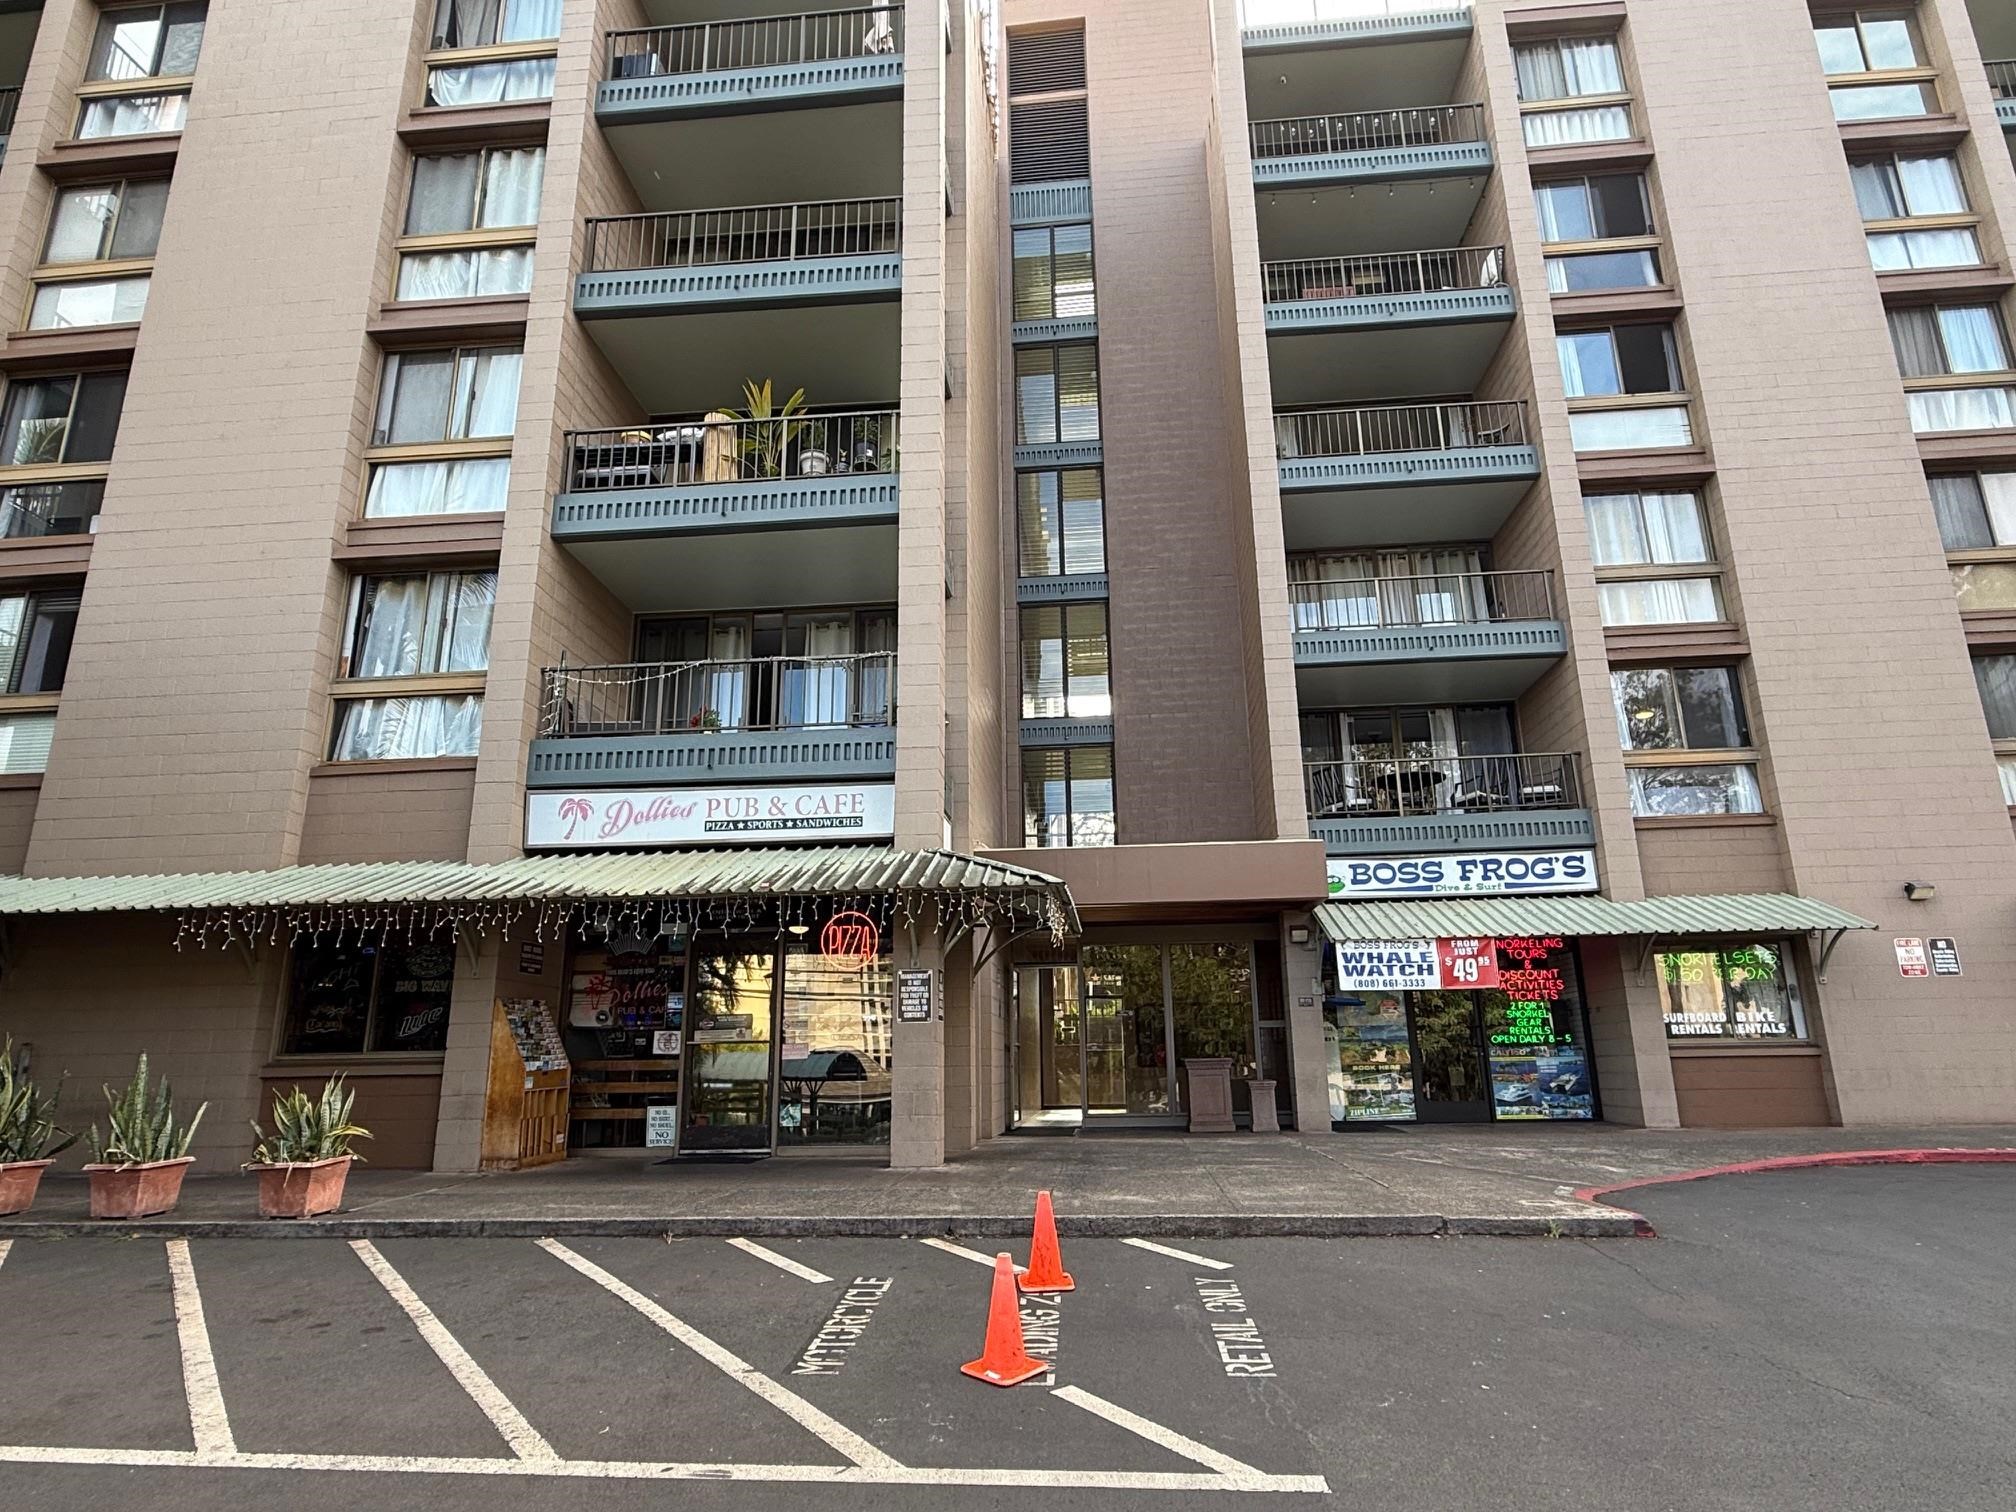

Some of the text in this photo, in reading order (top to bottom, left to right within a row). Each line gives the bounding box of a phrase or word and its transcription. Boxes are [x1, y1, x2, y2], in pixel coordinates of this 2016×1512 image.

[598, 793, 865, 839] Dollies PUB & CAFE
[706, 817, 862, 831] PIZZA SPORTS SANDWICHES
[1348, 855, 1587, 886] BOSS FROG'S
[1435, 882, 1502, 892] Dive & Surf
[828, 925, 871, 960] PIZZA
[1353, 940, 1419, 949] BOSS FROG'S
[1451, 939, 1479, 948] FROM
[1496, 938, 1563, 949] NORKELING
[1454, 947, 1478, 956] JUST
[1507, 949, 1547, 959] TOURS
[1341, 951, 1435, 964] WHALE
[1524, 960, 1532, 969] &
[1342, 964, 1434, 977] WATCH
[1499, 969, 1559, 980] DISCOUNT
[1748, 966, 1777, 980] DAY
[1353, 978, 1426, 988] (808) 661-3333
[1499, 980, 1565, 990] ACTIVITIES
[607, 979, 671, 1007] Dollies
[1507, 990, 1559, 1000] TICKETS
[617, 1006, 637, 1015] PUB
[1510, 1001, 1545, 1010] 2 FOR 1
[1506, 1009, 1550, 1018] SNORKEL
[1663, 1012, 1727, 1023] SURFBOARD
[1736, 1012, 1776, 1023] BIKE
[1516, 1018, 1542, 1026] GEAR
[1509, 1026, 1551, 1034] RENTALS
[1671, 1023, 1723, 1035] RENTALS
[1491, 1035, 1517, 1043] OPEN
[1519, 1034, 1546, 1043] DAILY
[1548, 1034, 1555, 1043] 8
[1565, 1034, 1572, 1042] 5
[655, 1131, 670, 1139] NO
[791, 1277, 893, 1375] MOTORCYCLE
[1194, 1277, 1277, 1377] RETAIL ONLY
[1016, 1308, 1060, 1387] LADING
